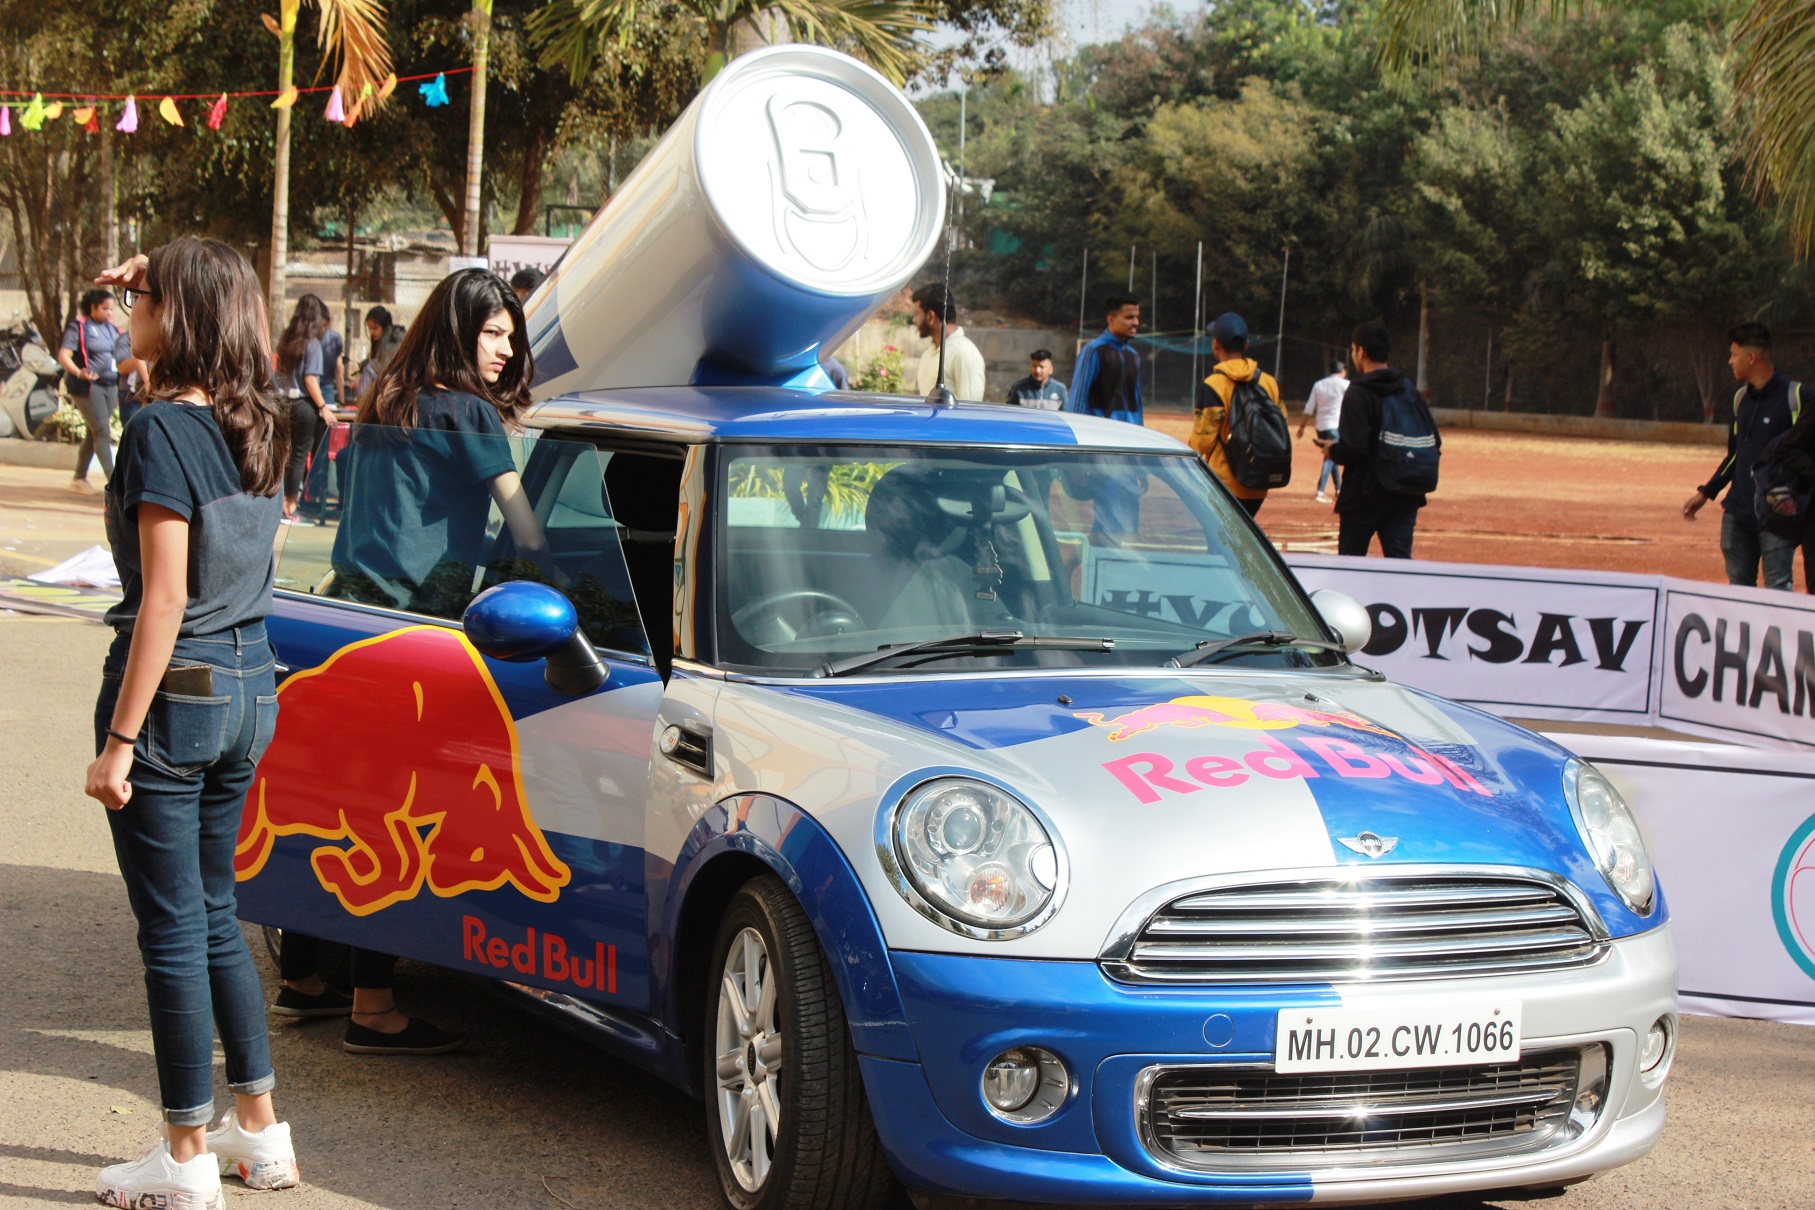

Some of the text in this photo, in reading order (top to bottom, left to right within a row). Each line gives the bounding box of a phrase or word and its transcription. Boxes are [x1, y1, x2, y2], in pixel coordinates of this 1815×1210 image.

[1100, 736, 1495, 804] Red Bull
[1361, 838, 1382, 848] MINI
[463, 914, 617, 994] Red Bull
[1288, 1020, 1514, 1061] MH.02.CW.1066
